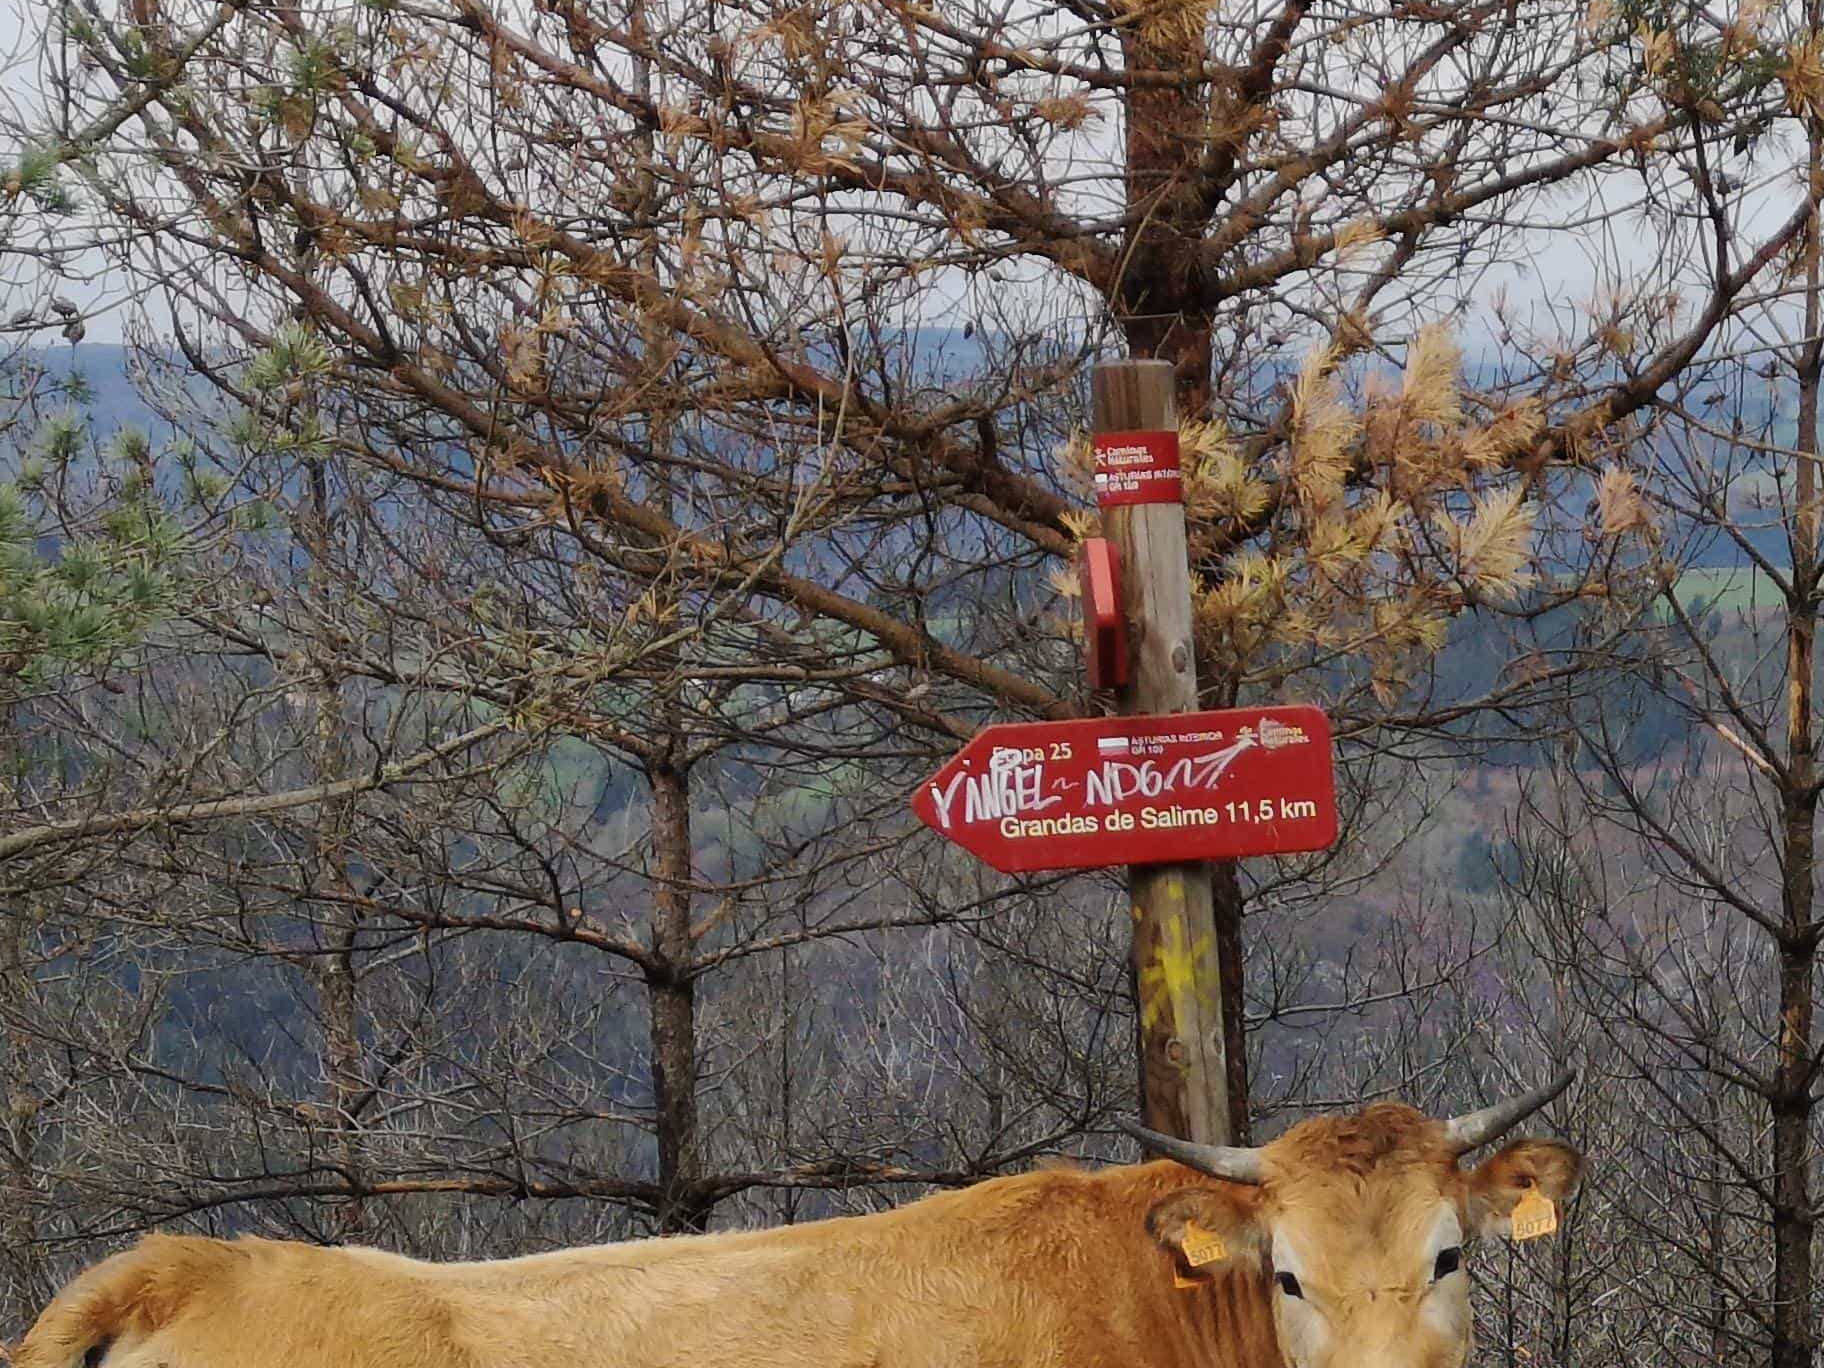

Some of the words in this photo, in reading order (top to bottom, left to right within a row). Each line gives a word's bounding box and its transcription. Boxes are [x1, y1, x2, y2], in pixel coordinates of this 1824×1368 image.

[992, 745, 1045, 765] Epa
[1049, 742, 1073, 761] 25
[1000, 811, 1098, 838] Grandas
[1104, 808, 1135, 832] de
[1141, 804, 1219, 829] Salime
[1225, 799, 1274, 825] 11,5
[1280, 797, 1317, 819] km
